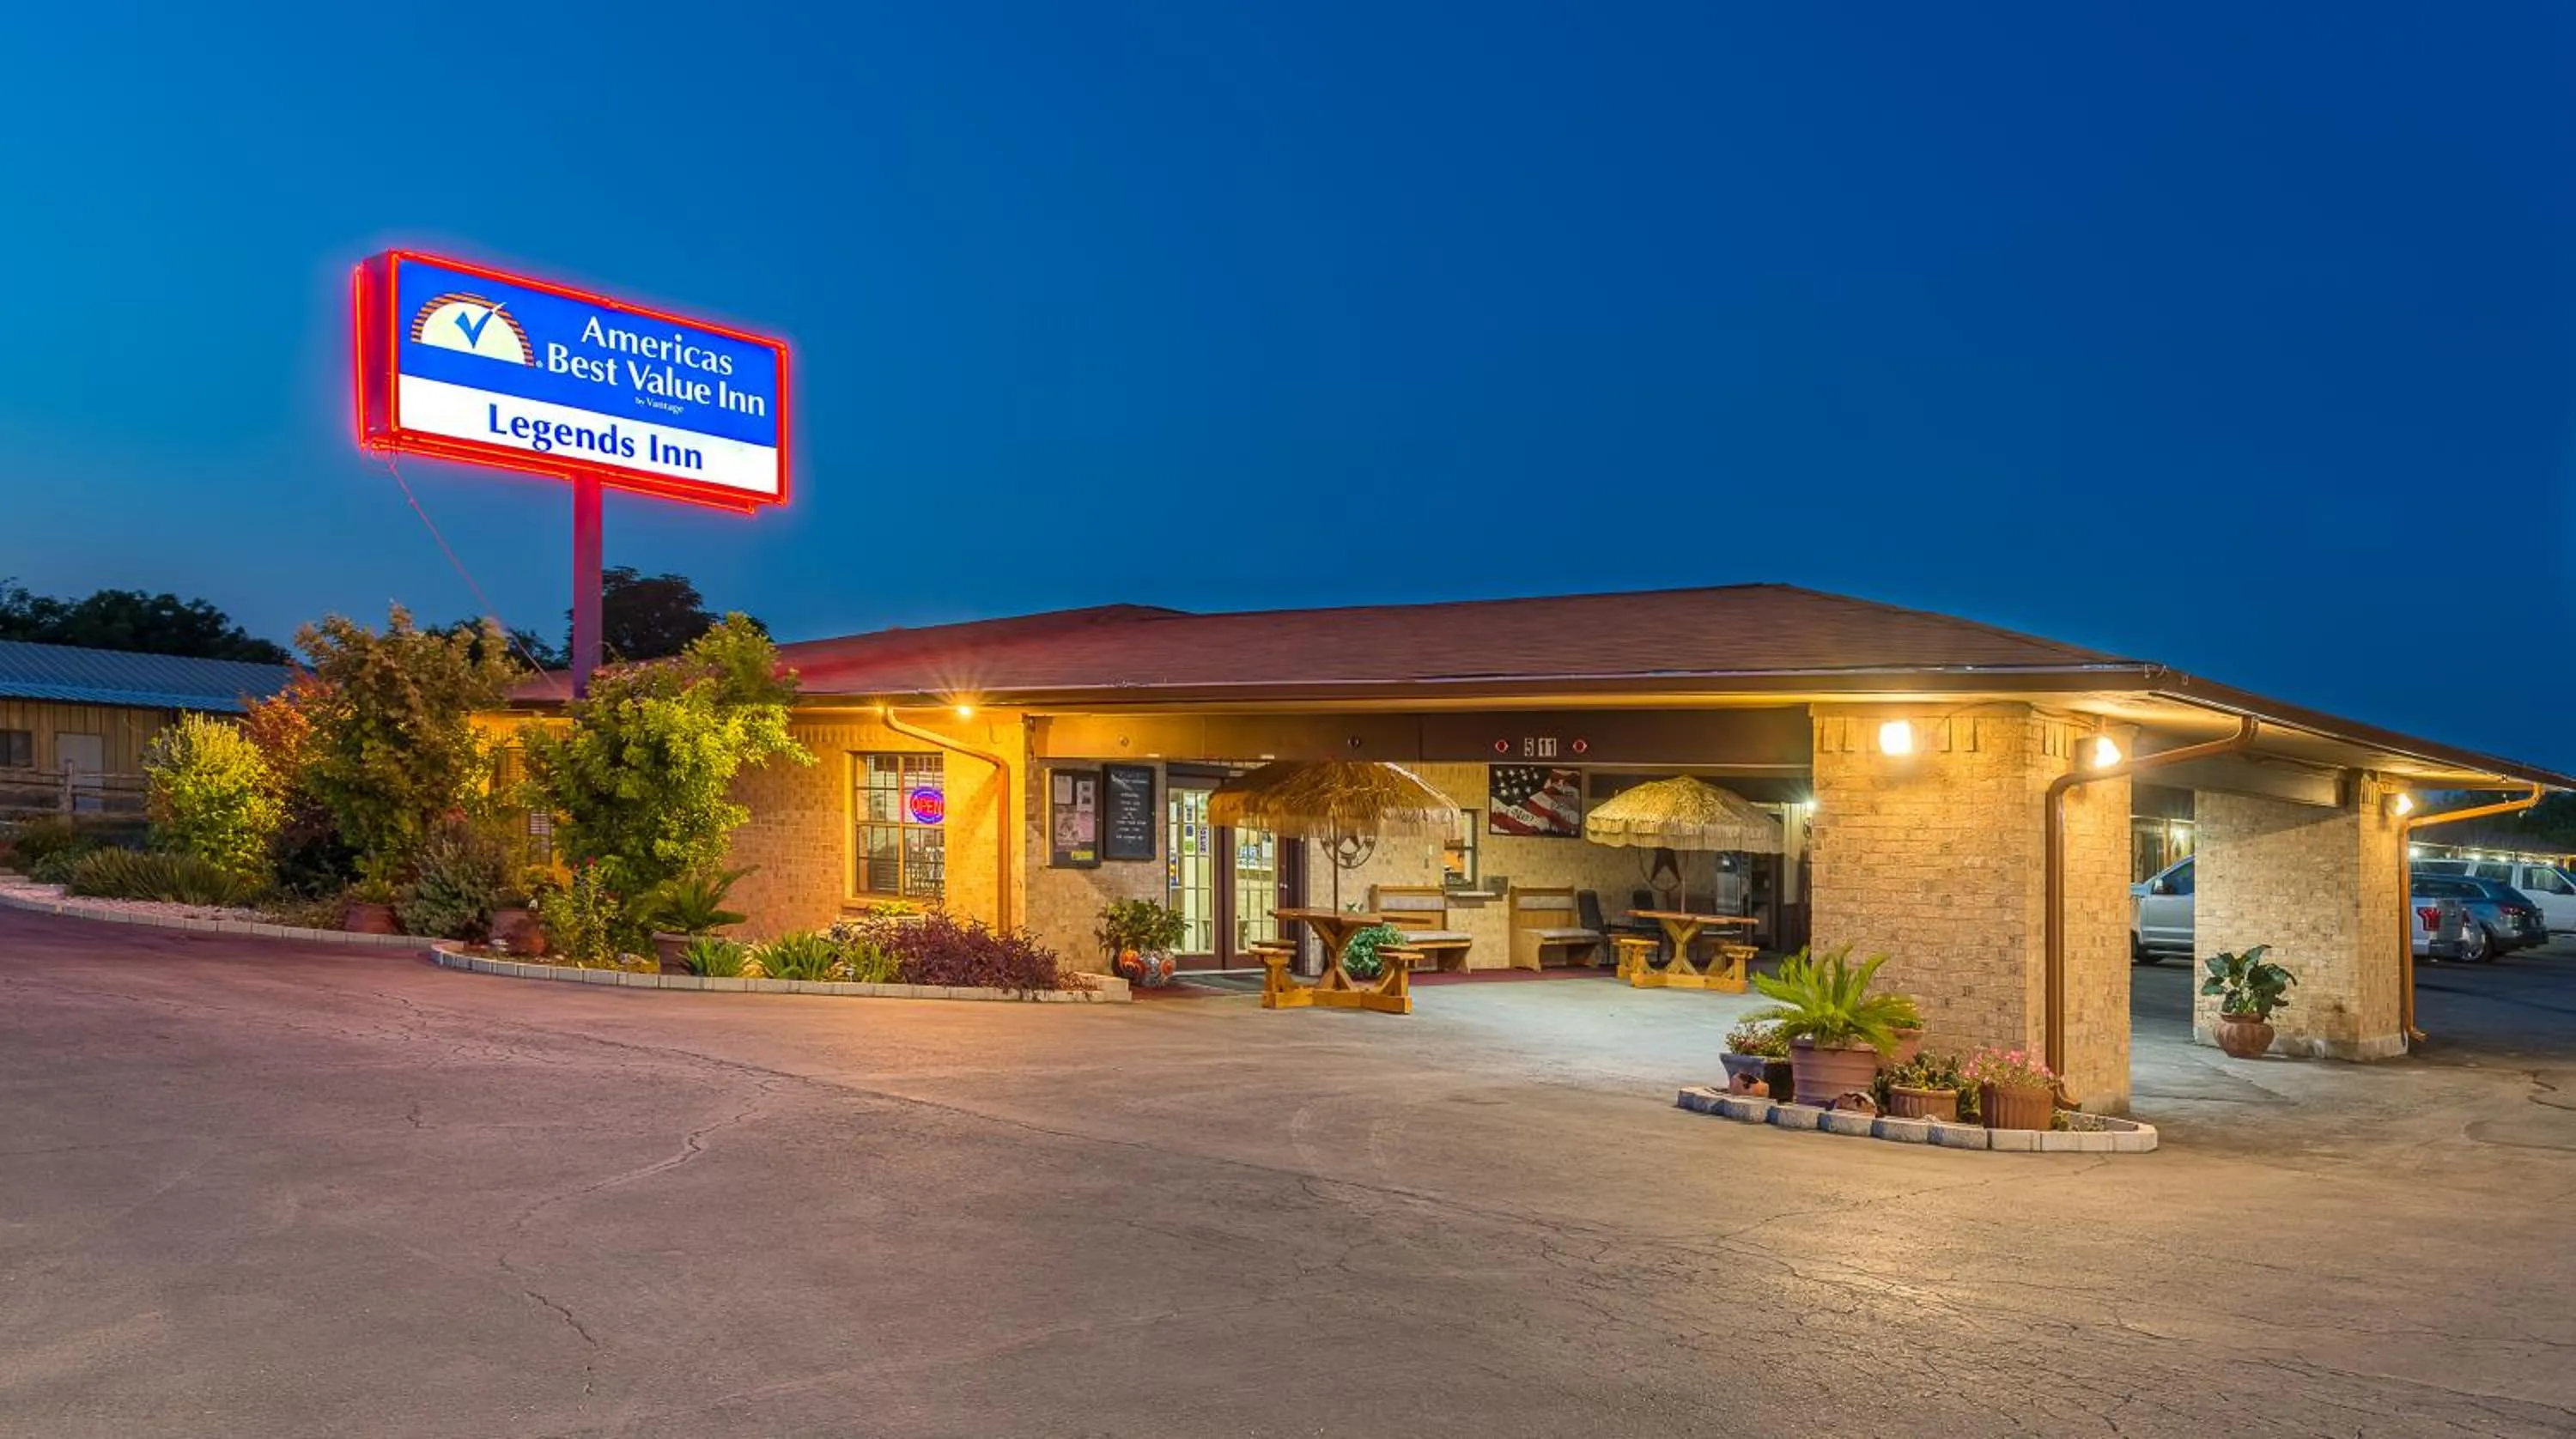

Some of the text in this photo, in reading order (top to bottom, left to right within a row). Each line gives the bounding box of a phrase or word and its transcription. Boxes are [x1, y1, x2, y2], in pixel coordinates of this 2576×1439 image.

[581, 315, 732, 375] Americas
[548, 343, 766, 416] Best Value Inn
[646, 397, 684, 416] Vantage
[489, 403, 703, 470] Legends Inn
[911, 798, 943, 815] OPEN
